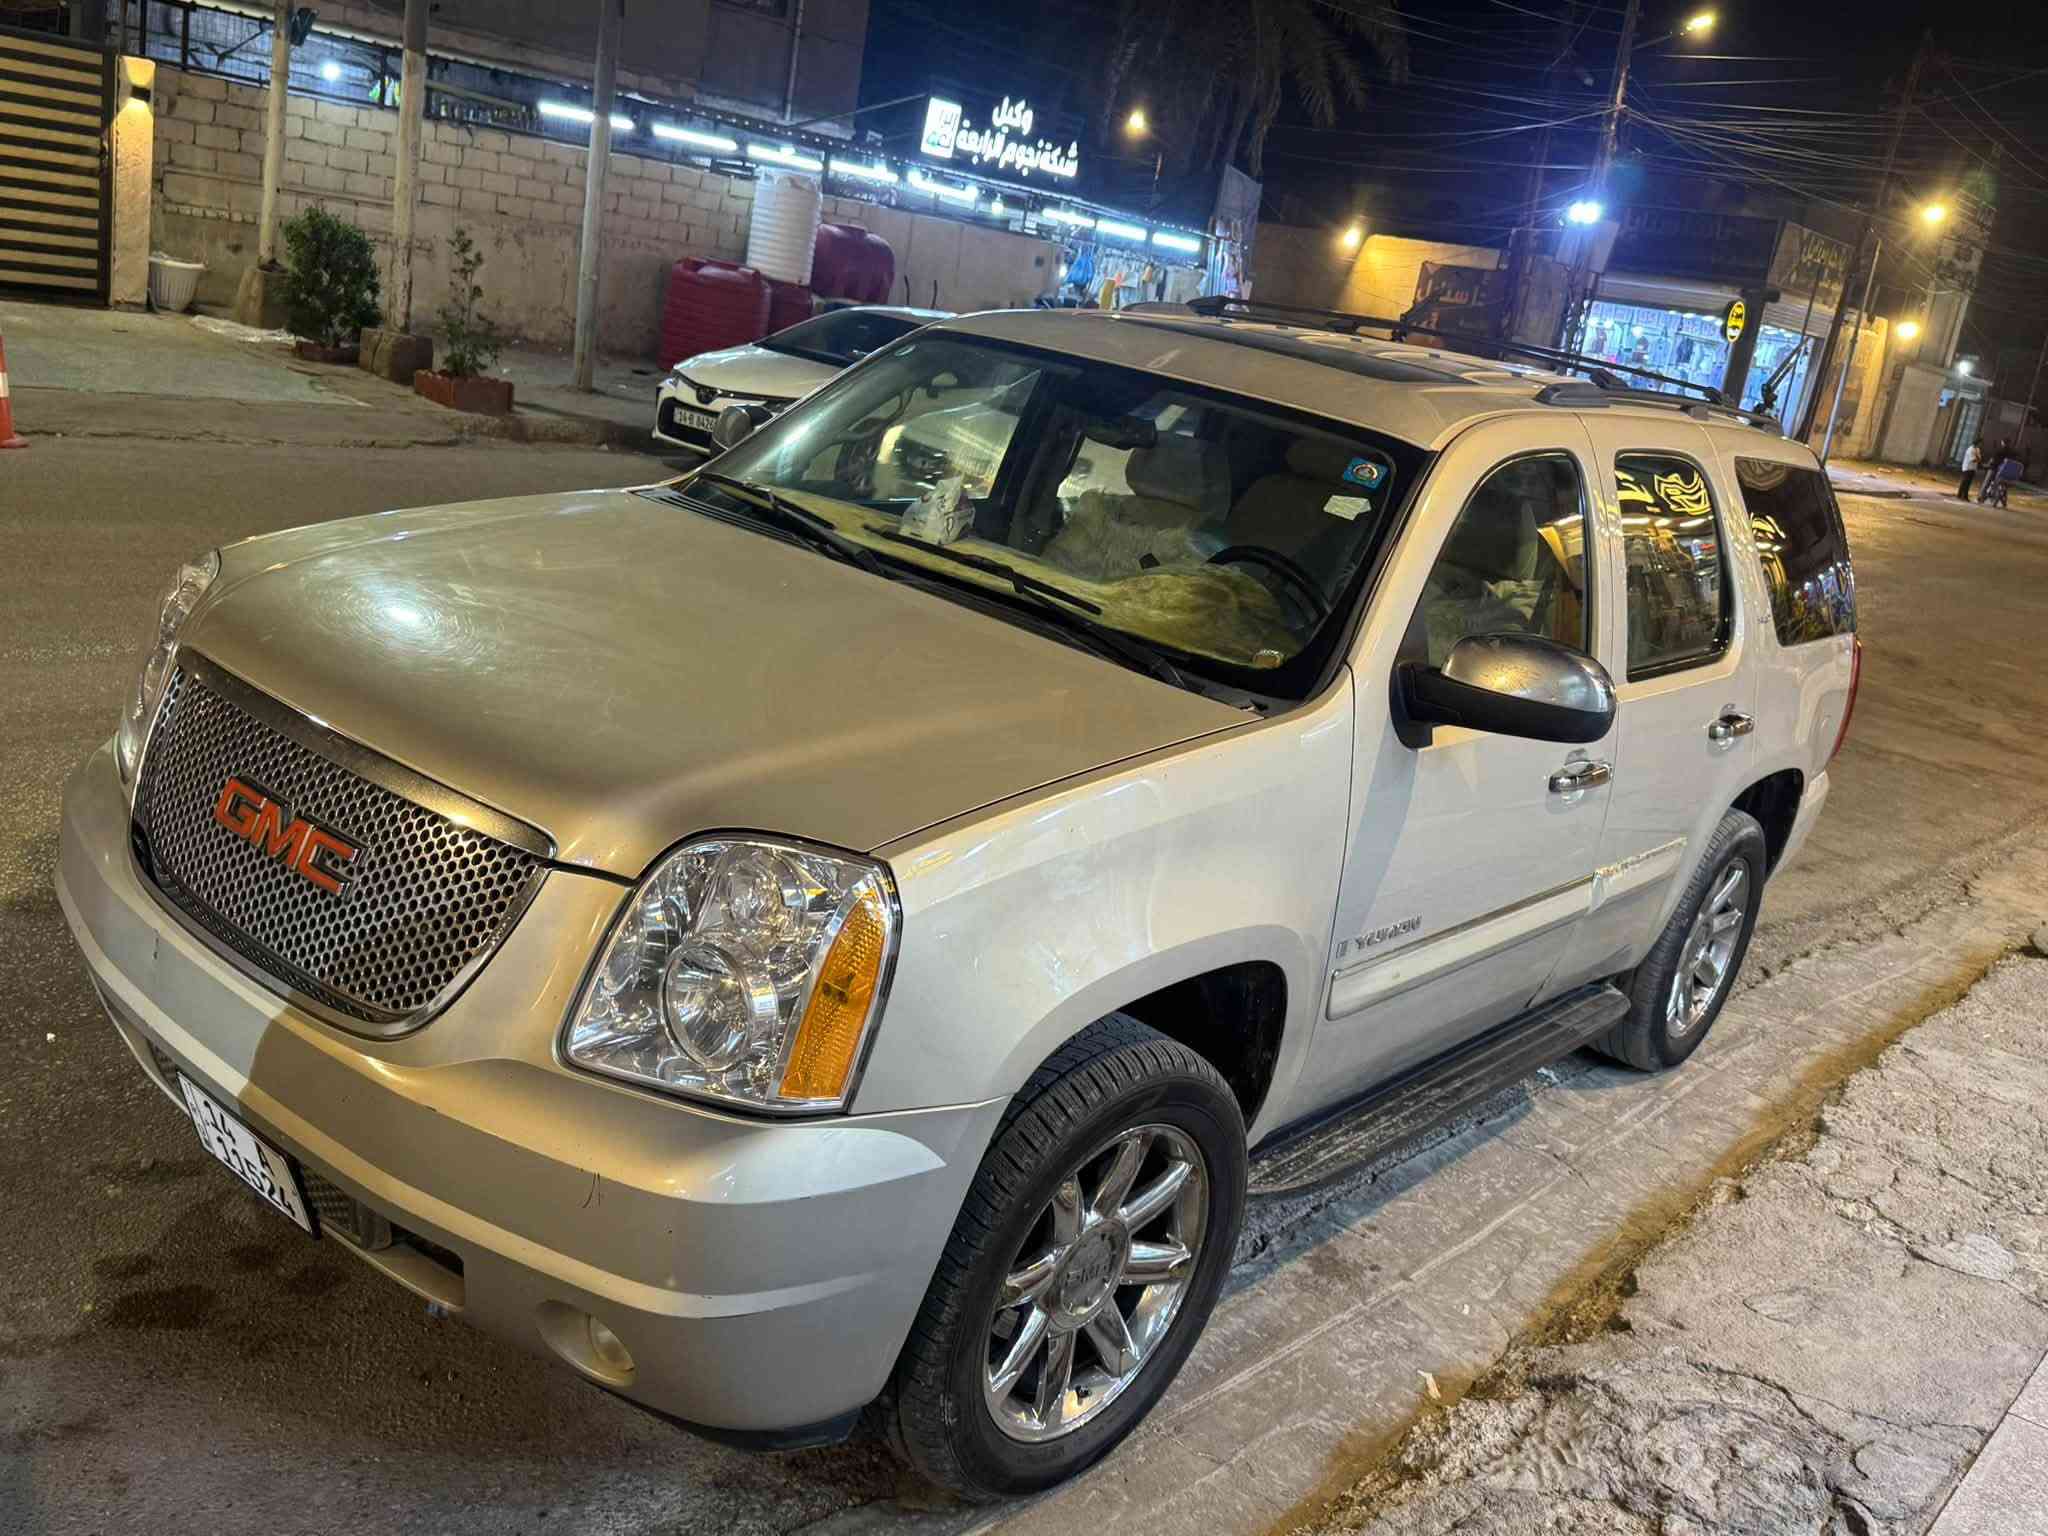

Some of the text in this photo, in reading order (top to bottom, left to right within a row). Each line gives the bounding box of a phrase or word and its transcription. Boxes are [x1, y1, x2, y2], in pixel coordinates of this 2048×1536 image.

[992, 96, 1034, 135] وكيل
[999, 138, 1044, 176] نجوم
[1039, 140, 1078, 182] شبكة
[215, 776, 362, 897] GMC
[203, 1100, 236, 1145] 14
[254, 1140, 276, 1177] A
[216, 1135, 296, 1218] 11524
